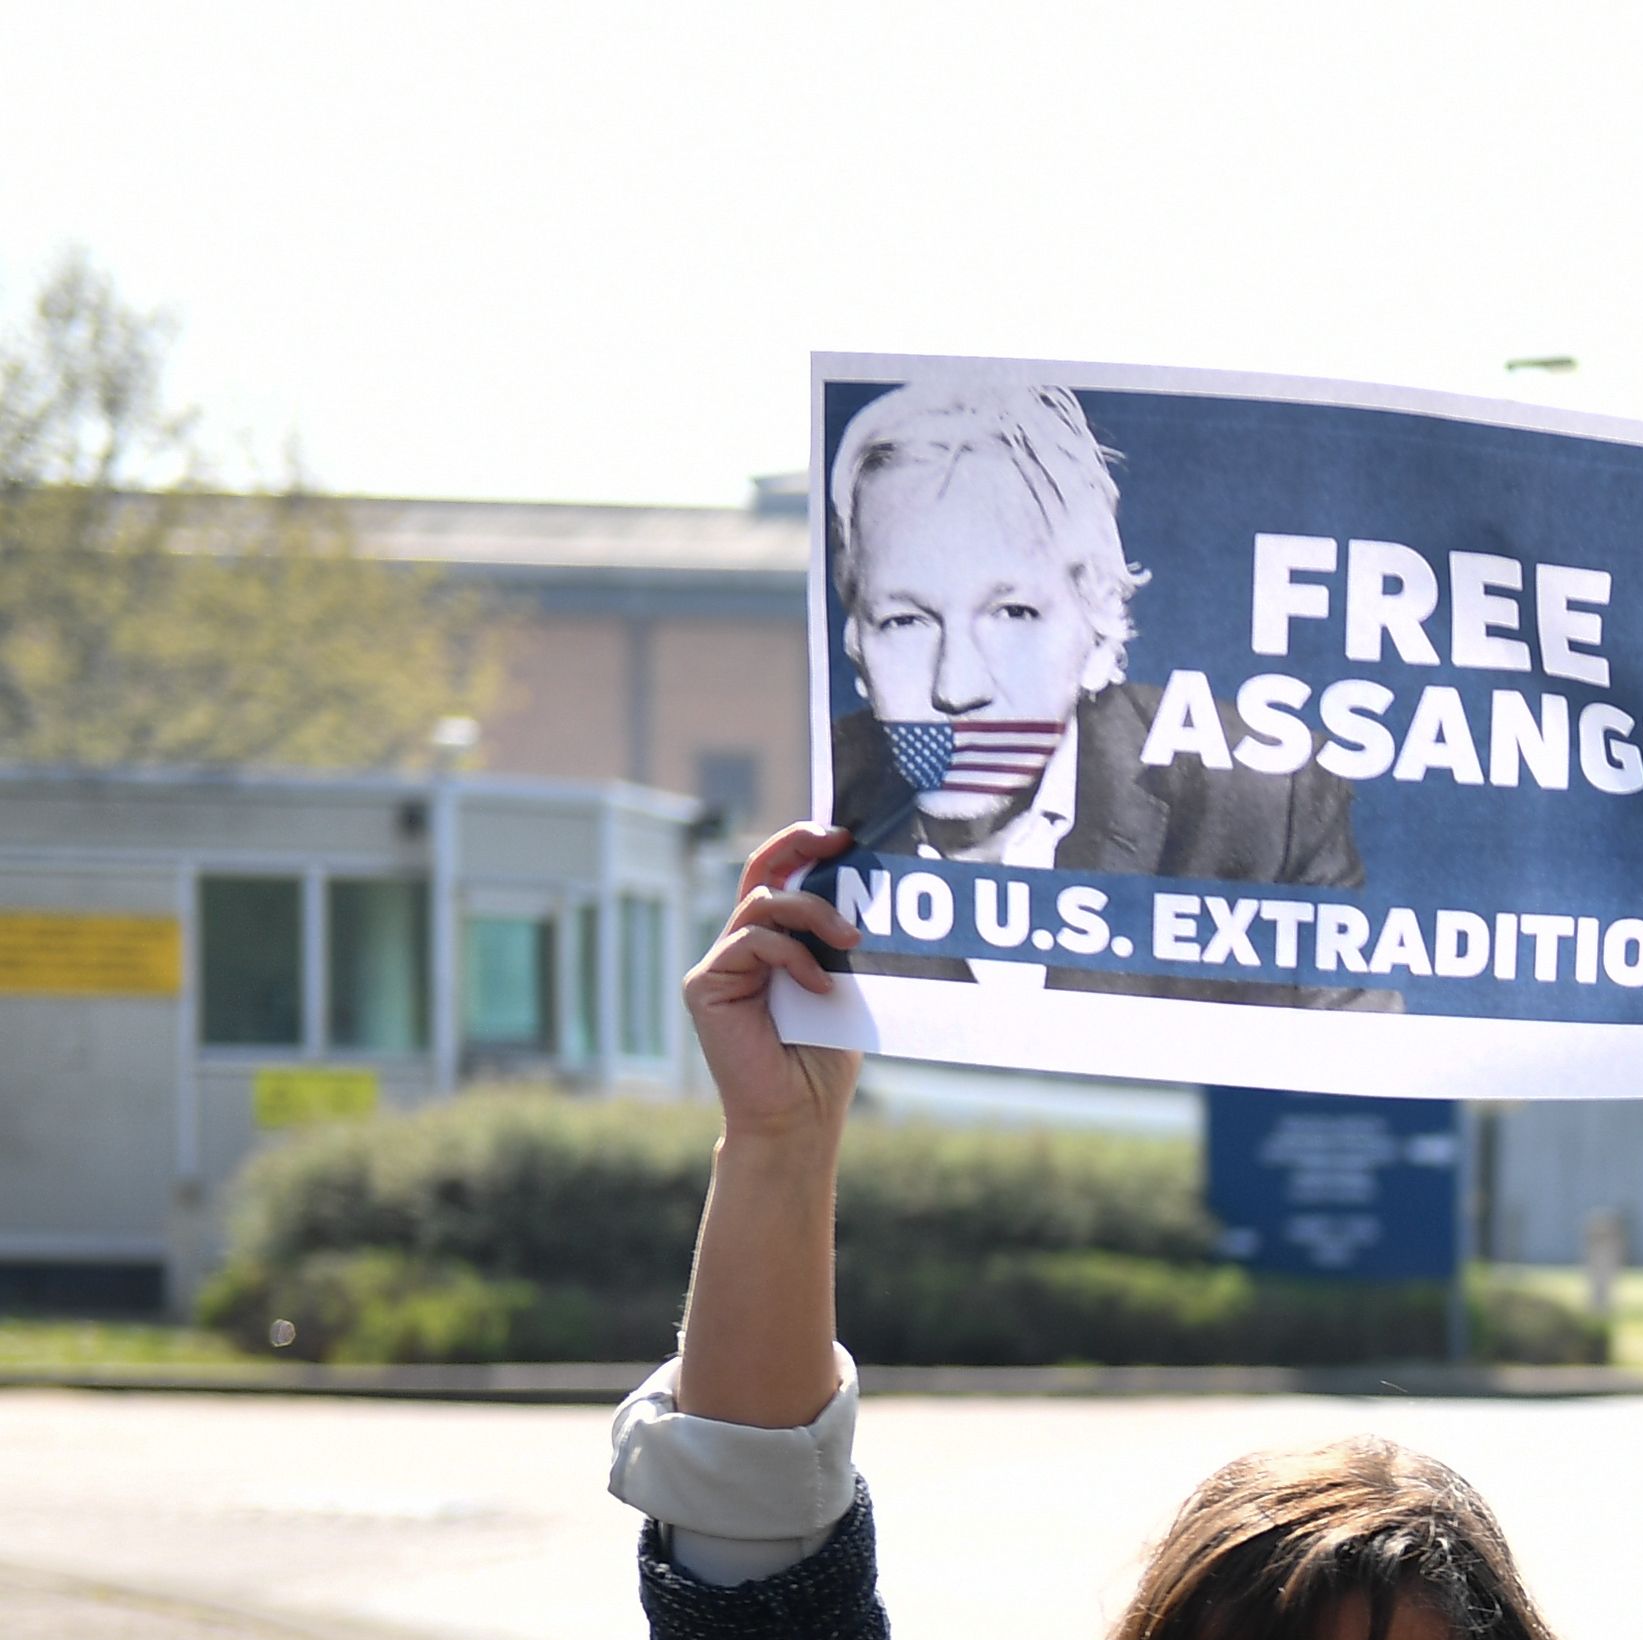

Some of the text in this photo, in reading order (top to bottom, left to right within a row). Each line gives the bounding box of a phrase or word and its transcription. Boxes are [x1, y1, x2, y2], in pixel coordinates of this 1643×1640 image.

[1250, 532, 1613, 688] FREE
[836, 866, 955, 942] NO
[973, 877, 1135, 959] U.S.
